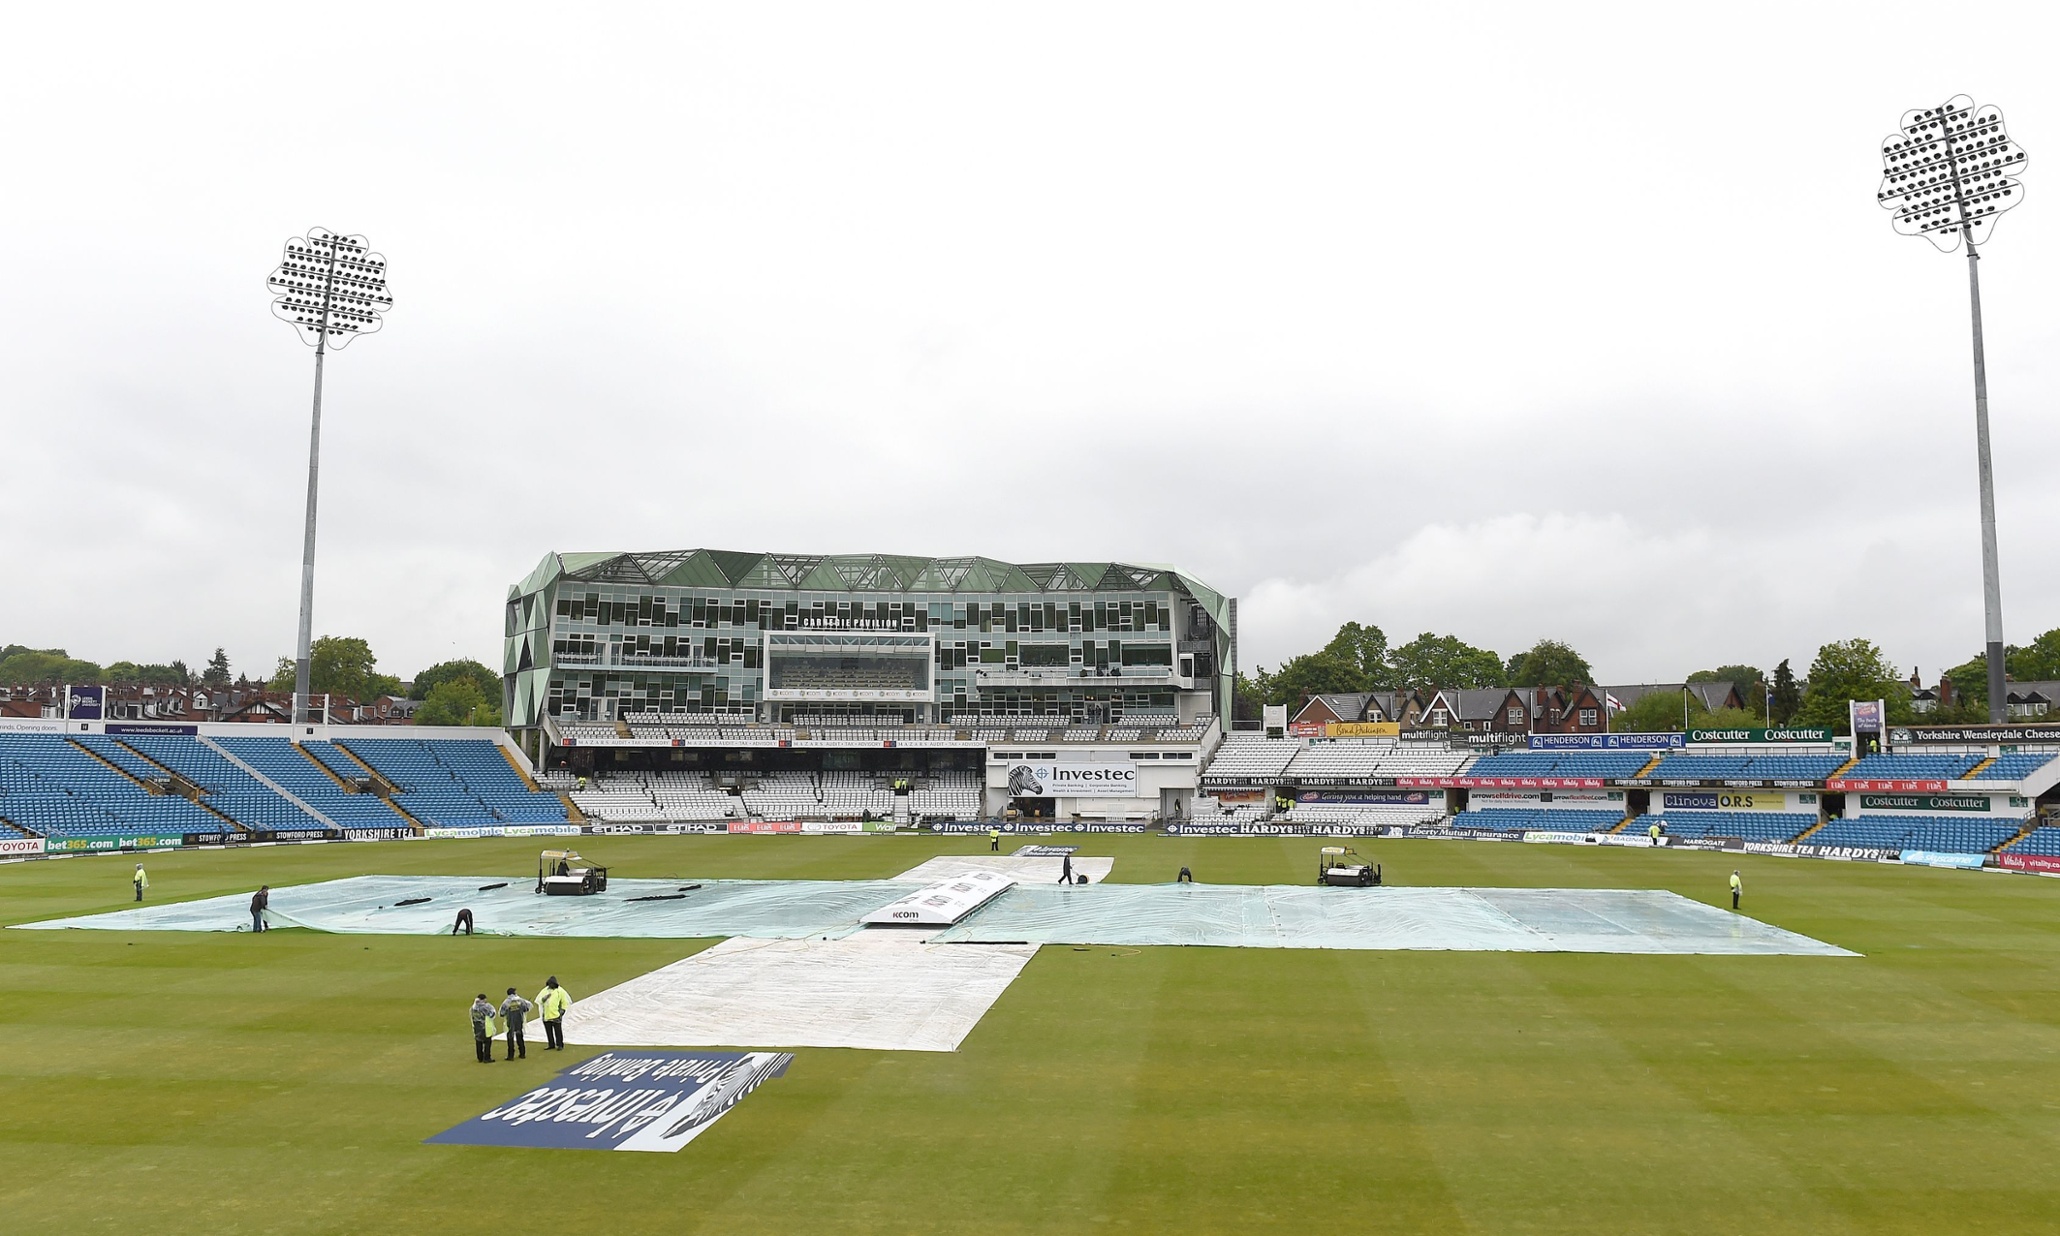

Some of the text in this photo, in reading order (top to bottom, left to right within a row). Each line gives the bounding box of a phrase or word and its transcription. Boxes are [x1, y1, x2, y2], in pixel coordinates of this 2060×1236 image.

[803, 618, 897, 628] CARNEGIE PAVILION
[1336, 724, 1387, 735] Bond Dickinson
[1402, 730, 1448, 740] multiflight
[1692, 730, 1750, 740] Costcutter
[1764, 729, 1824, 740] Costcutter
[1916, 731, 1960, 740] Yorkshire
[1962, 730, 2022, 741] Wensleydale
[2024, 729, 2060, 739] Cheese
[1468, 732, 1526, 744] multiflight
[1620, 736, 1668, 744] HENDERSON
[1053, 767, 1134, 780] Investec
[1665, 795, 1753, 808] Clinova O.R.S
[1866, 796, 1919, 806] Costcutter
[1930, 797, 1984, 808] Costcutter
[426, 828, 504, 837] Lycamobile
[504, 826, 578, 835] Lycamobile
[1015, 823, 1073, 832] Investec
[1086, 824, 1144, 832] Investec
[1179, 825, 1237, 834] Investec
[1240, 825, 1293, 834] HARDYS
[1312, 826, 1365, 834] HARDYS
[276, 832, 305, 840] STOWFORD
[344, 828, 414, 840] YORKSHIRE TEA
[1473, 830, 1519, 838] Insurance
[48, 838, 113, 850] bet365.com
[119, 836, 181, 847] bet365.com
[1743, 842, 1814, 855] YORKSHIRE TEA
[1819, 846, 1880, 858] HARDYS
[1925, 854, 1975, 864] skyscanner
[2004, 855, 2025, 869] Vitality
[570, 1053, 733, 1084] Private Banking
[481, 1088, 666, 1138] Investec
